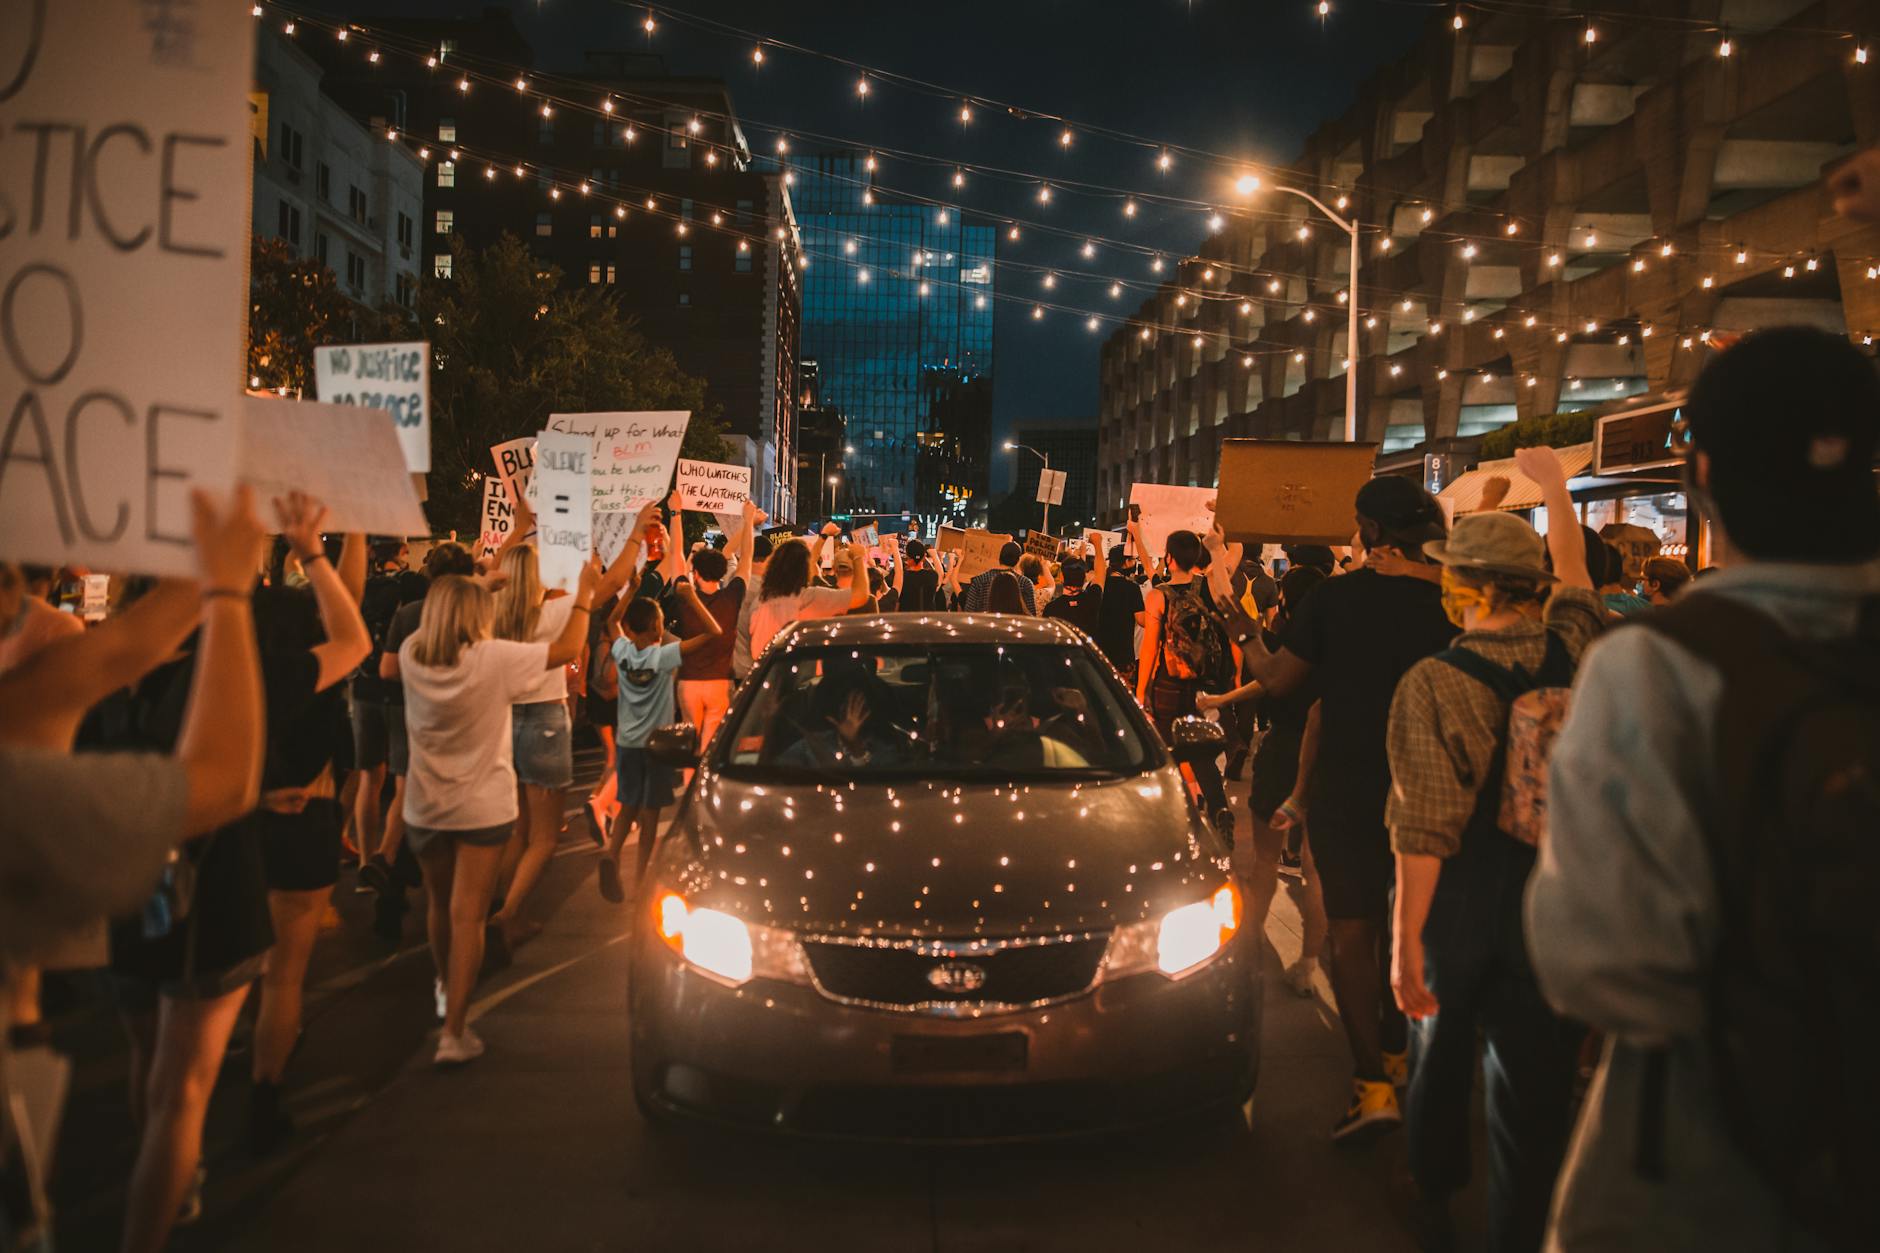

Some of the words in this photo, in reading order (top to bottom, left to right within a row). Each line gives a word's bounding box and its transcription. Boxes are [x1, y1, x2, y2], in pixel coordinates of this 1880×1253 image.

[604, 427, 620, 440] up
[626, 422, 647, 437] for
[680, 462, 706, 478] WHO
[706, 469, 748, 484] WATCHES
[680, 482, 698, 497] THE
[700, 485, 748, 503] WATCHERS
[696, 501, 724, 510] #ACAB
[769, 531, 793, 541] BLACK
